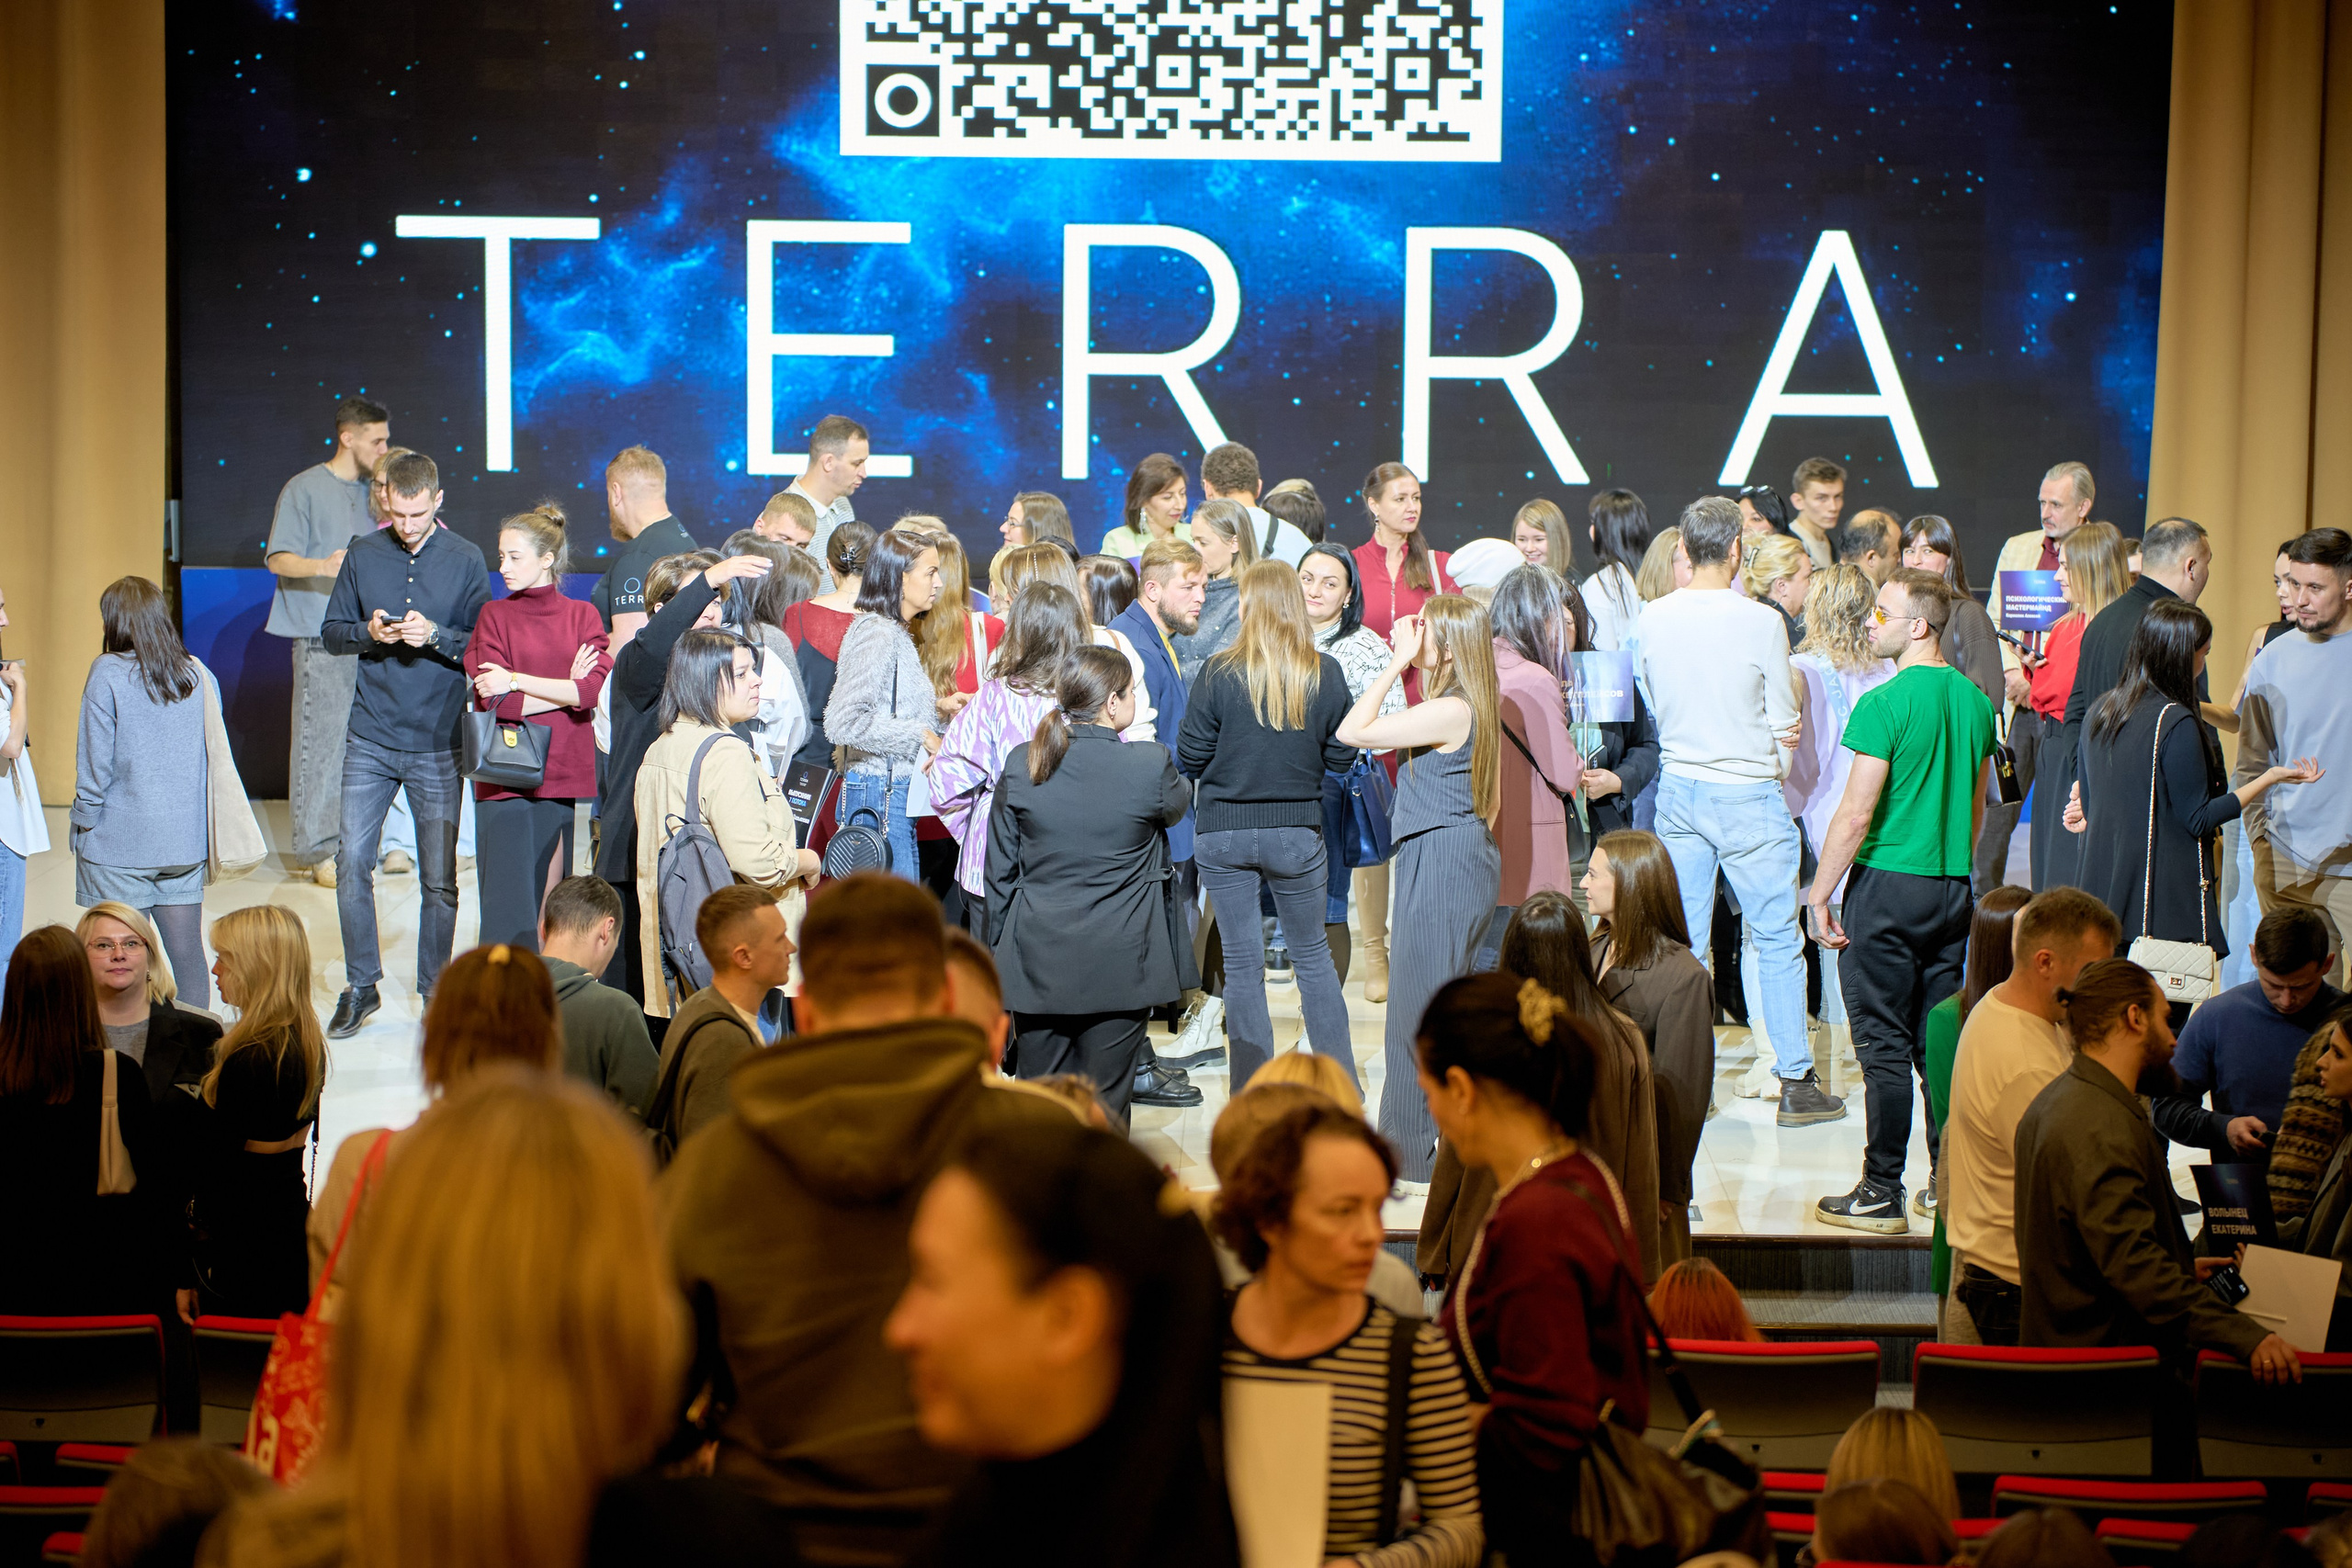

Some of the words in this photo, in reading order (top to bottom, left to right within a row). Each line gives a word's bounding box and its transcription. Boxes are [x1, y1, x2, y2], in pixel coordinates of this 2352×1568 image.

[395, 215, 1939, 488] TERRA
[615, 594, 644, 606] TERR
[2006, 604, 2052, 612] МАСТЕРМАЙНД
[2208, 1207, 2249, 1220] ВОЛЫНЕЦ
[2211, 1224, 2257, 1235] ЕКАТЕРИНА
